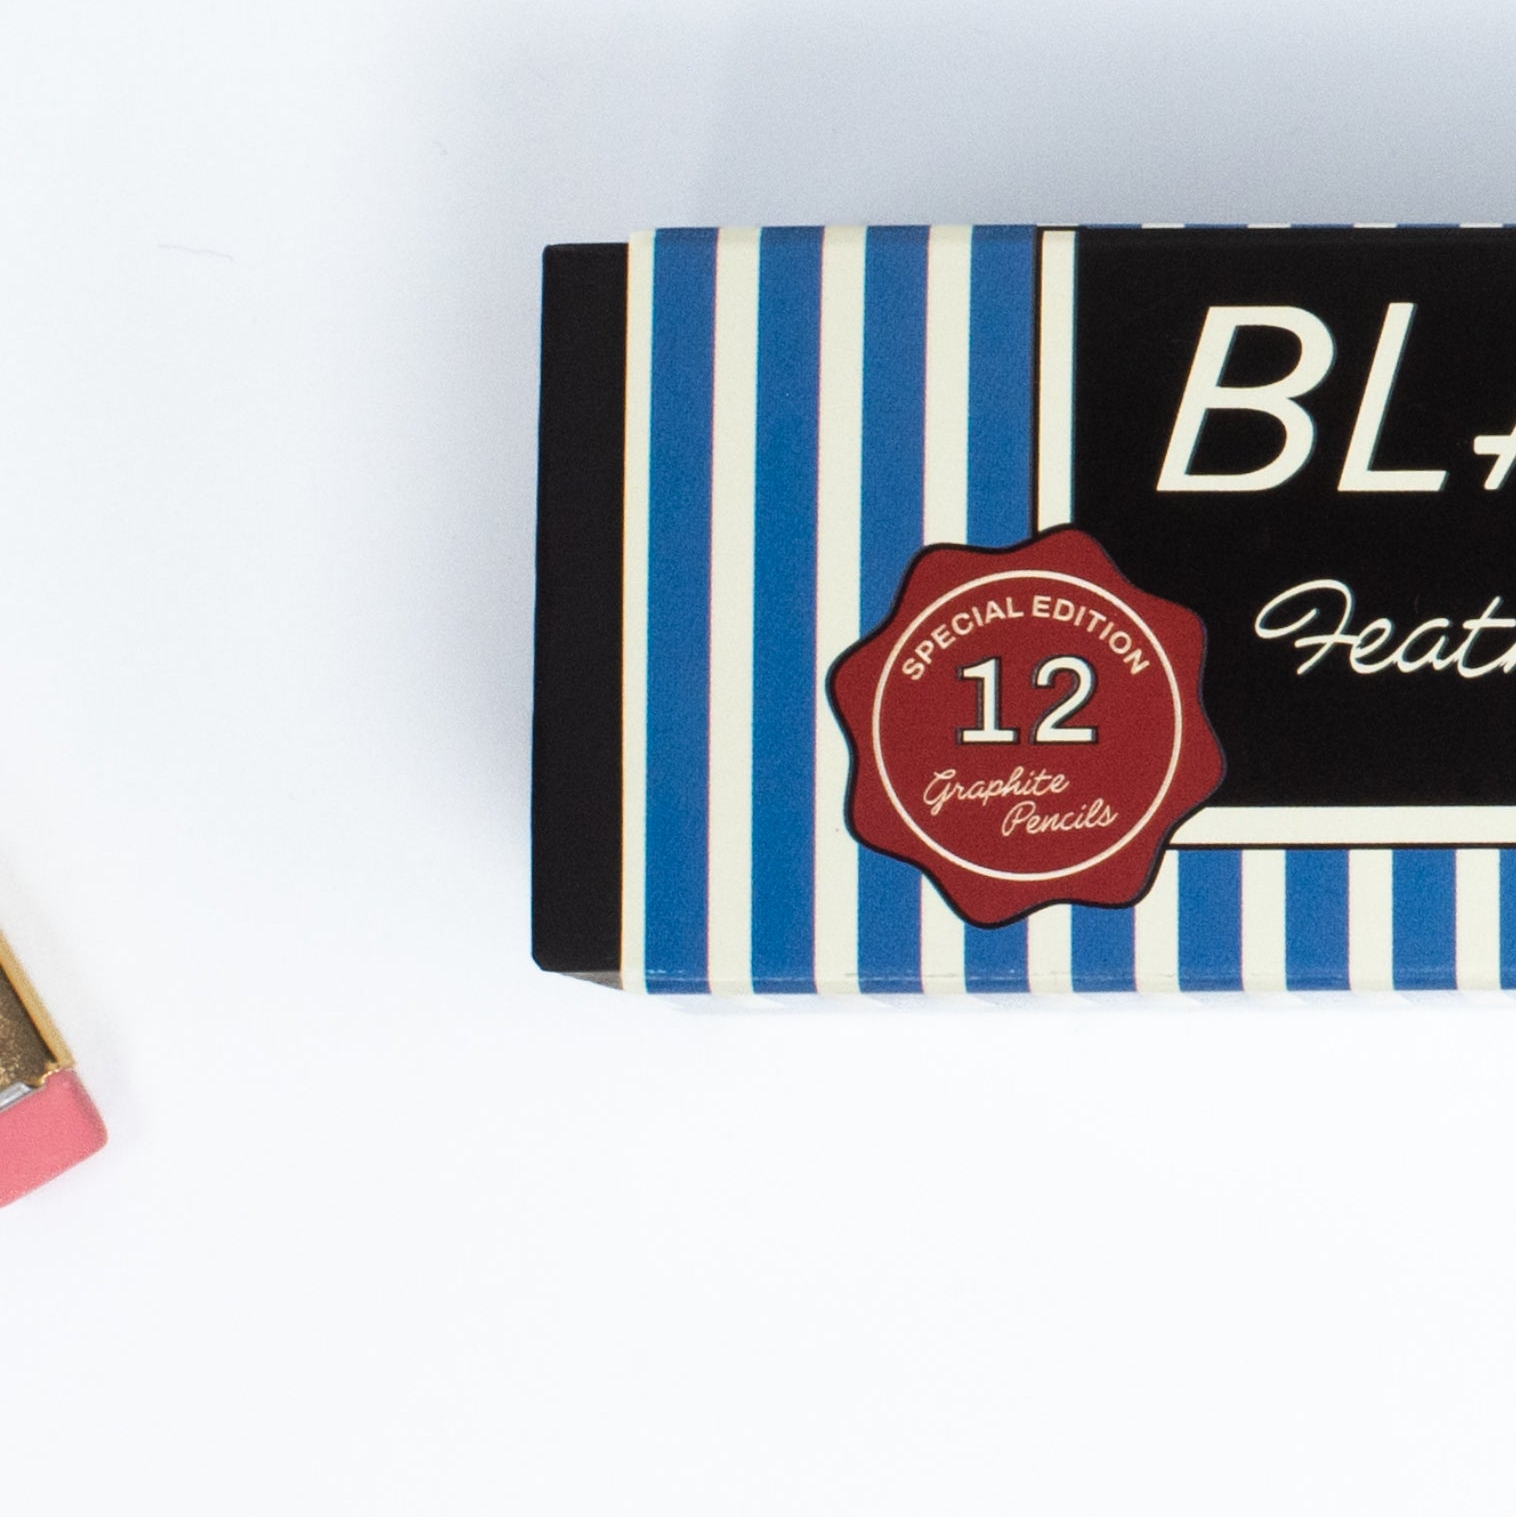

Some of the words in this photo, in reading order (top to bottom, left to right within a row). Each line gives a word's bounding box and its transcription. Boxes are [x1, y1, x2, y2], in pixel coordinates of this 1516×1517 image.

[901, 596, 1025, 681] SPECIAL
[1031, 594, 1150, 676] EDITION
[955, 655, 1099, 745] 12
[922, 766, 1070, 817] Graphite
[1001, 798, 1119, 837] Pencils
